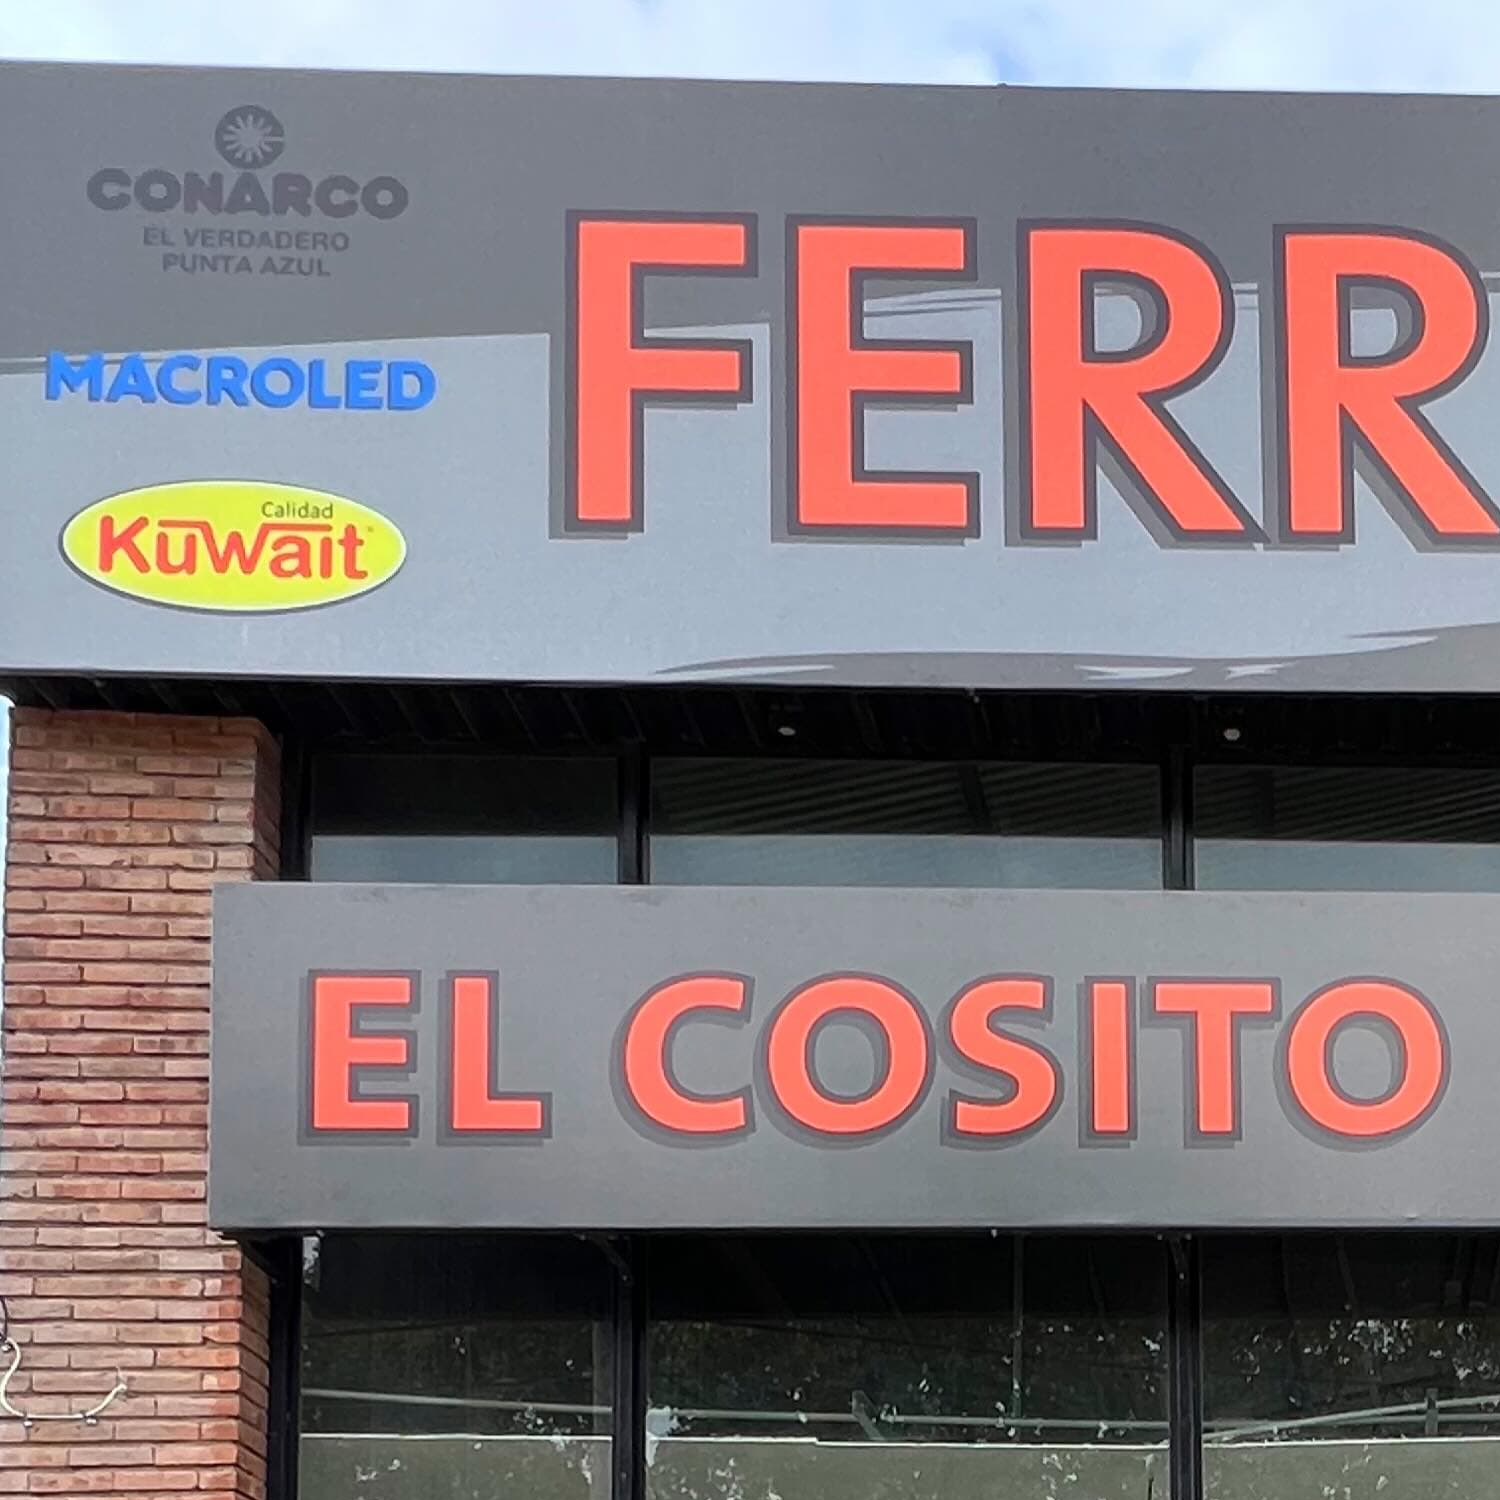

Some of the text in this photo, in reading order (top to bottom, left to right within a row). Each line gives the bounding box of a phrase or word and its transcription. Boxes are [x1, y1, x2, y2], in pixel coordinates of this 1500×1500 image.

[86, 167, 409, 220] CONARCO
[142, 226, 350, 252] EL VERDADERO
[162, 253, 331, 277] PUNTA AZUL
[45, 351, 436, 411] MACROLED
[261, 501, 333, 519] Calidad
[307, 970, 549, 1139] EL
[615, 972, 1449, 1140] COSITO
